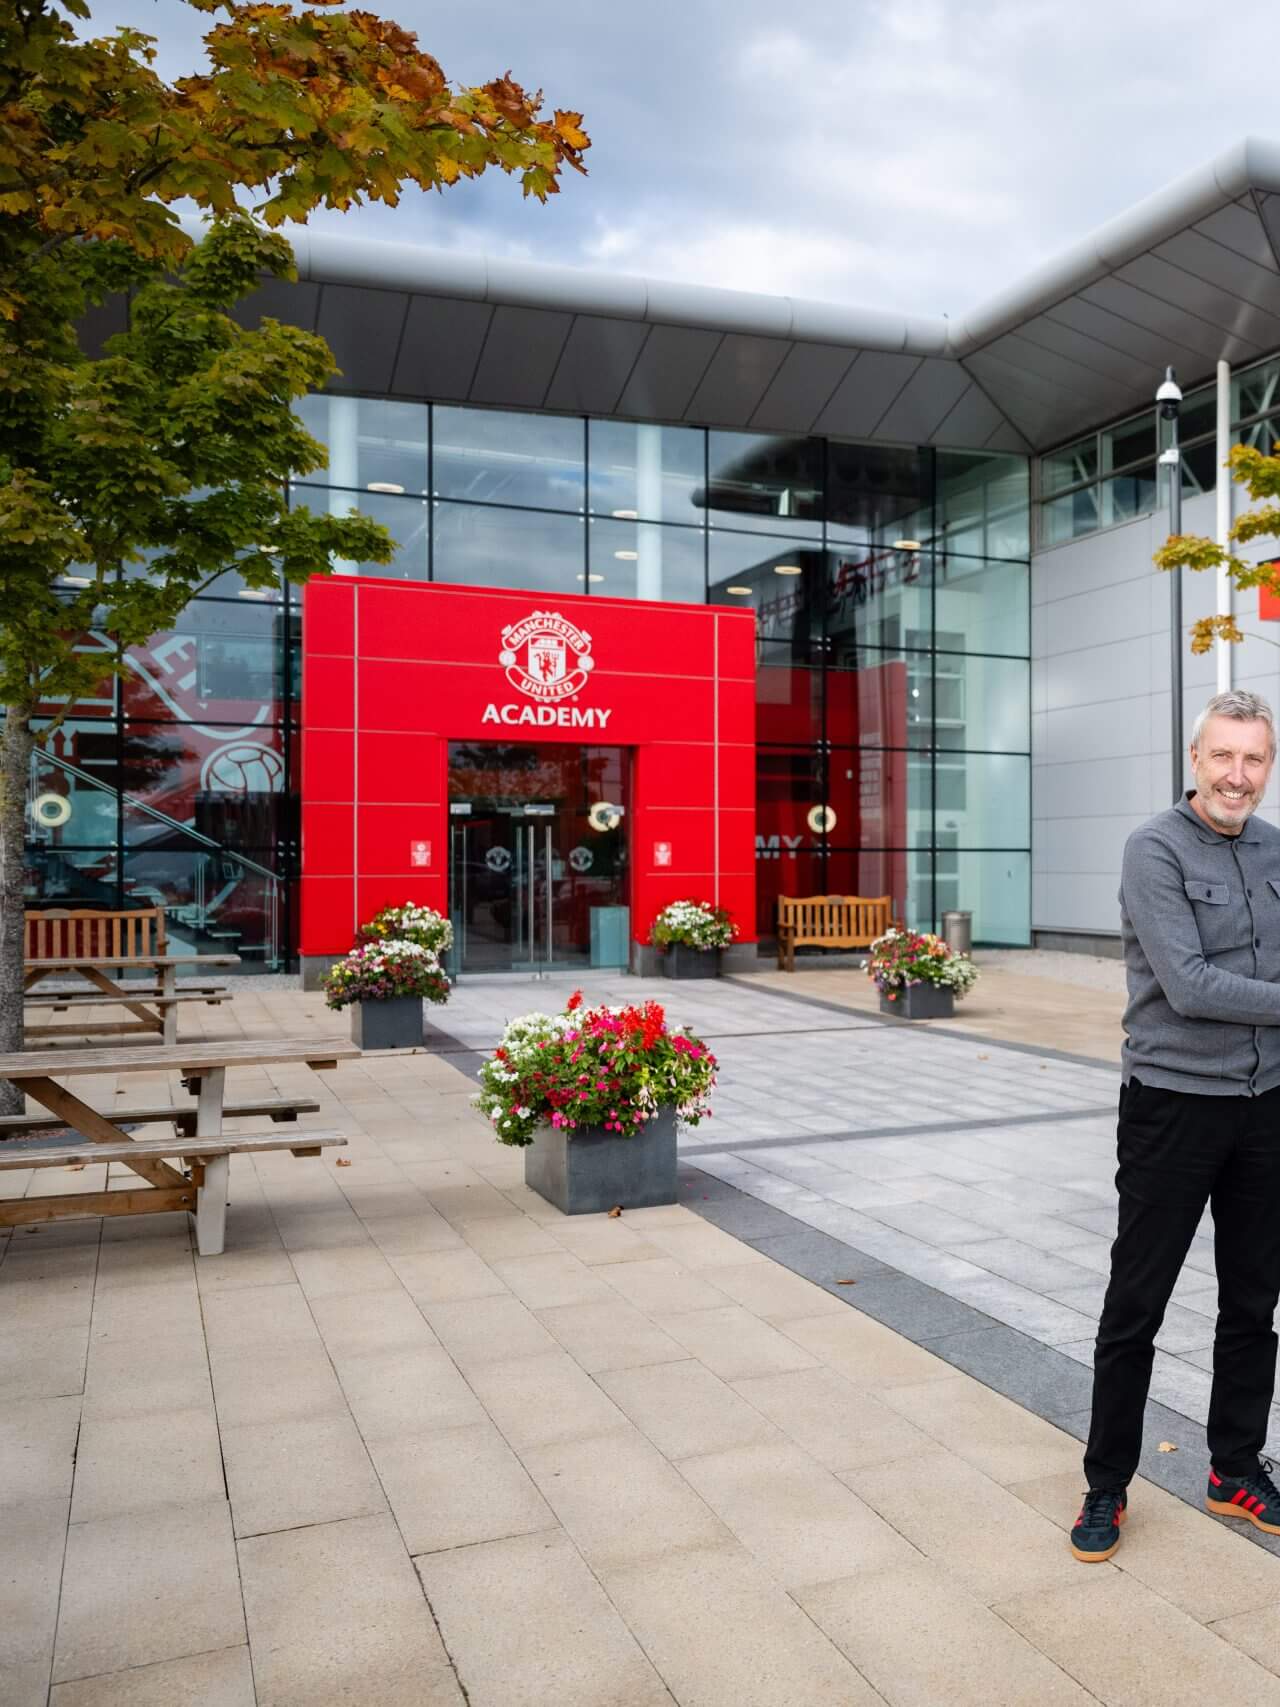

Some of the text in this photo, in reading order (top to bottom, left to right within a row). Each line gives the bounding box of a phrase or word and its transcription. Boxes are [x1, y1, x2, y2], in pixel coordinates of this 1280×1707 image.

[508, 618, 586, 650] MANCHESTER
[520, 678, 574, 696] UNITED
[481, 703, 612, 729] ACADEMY
